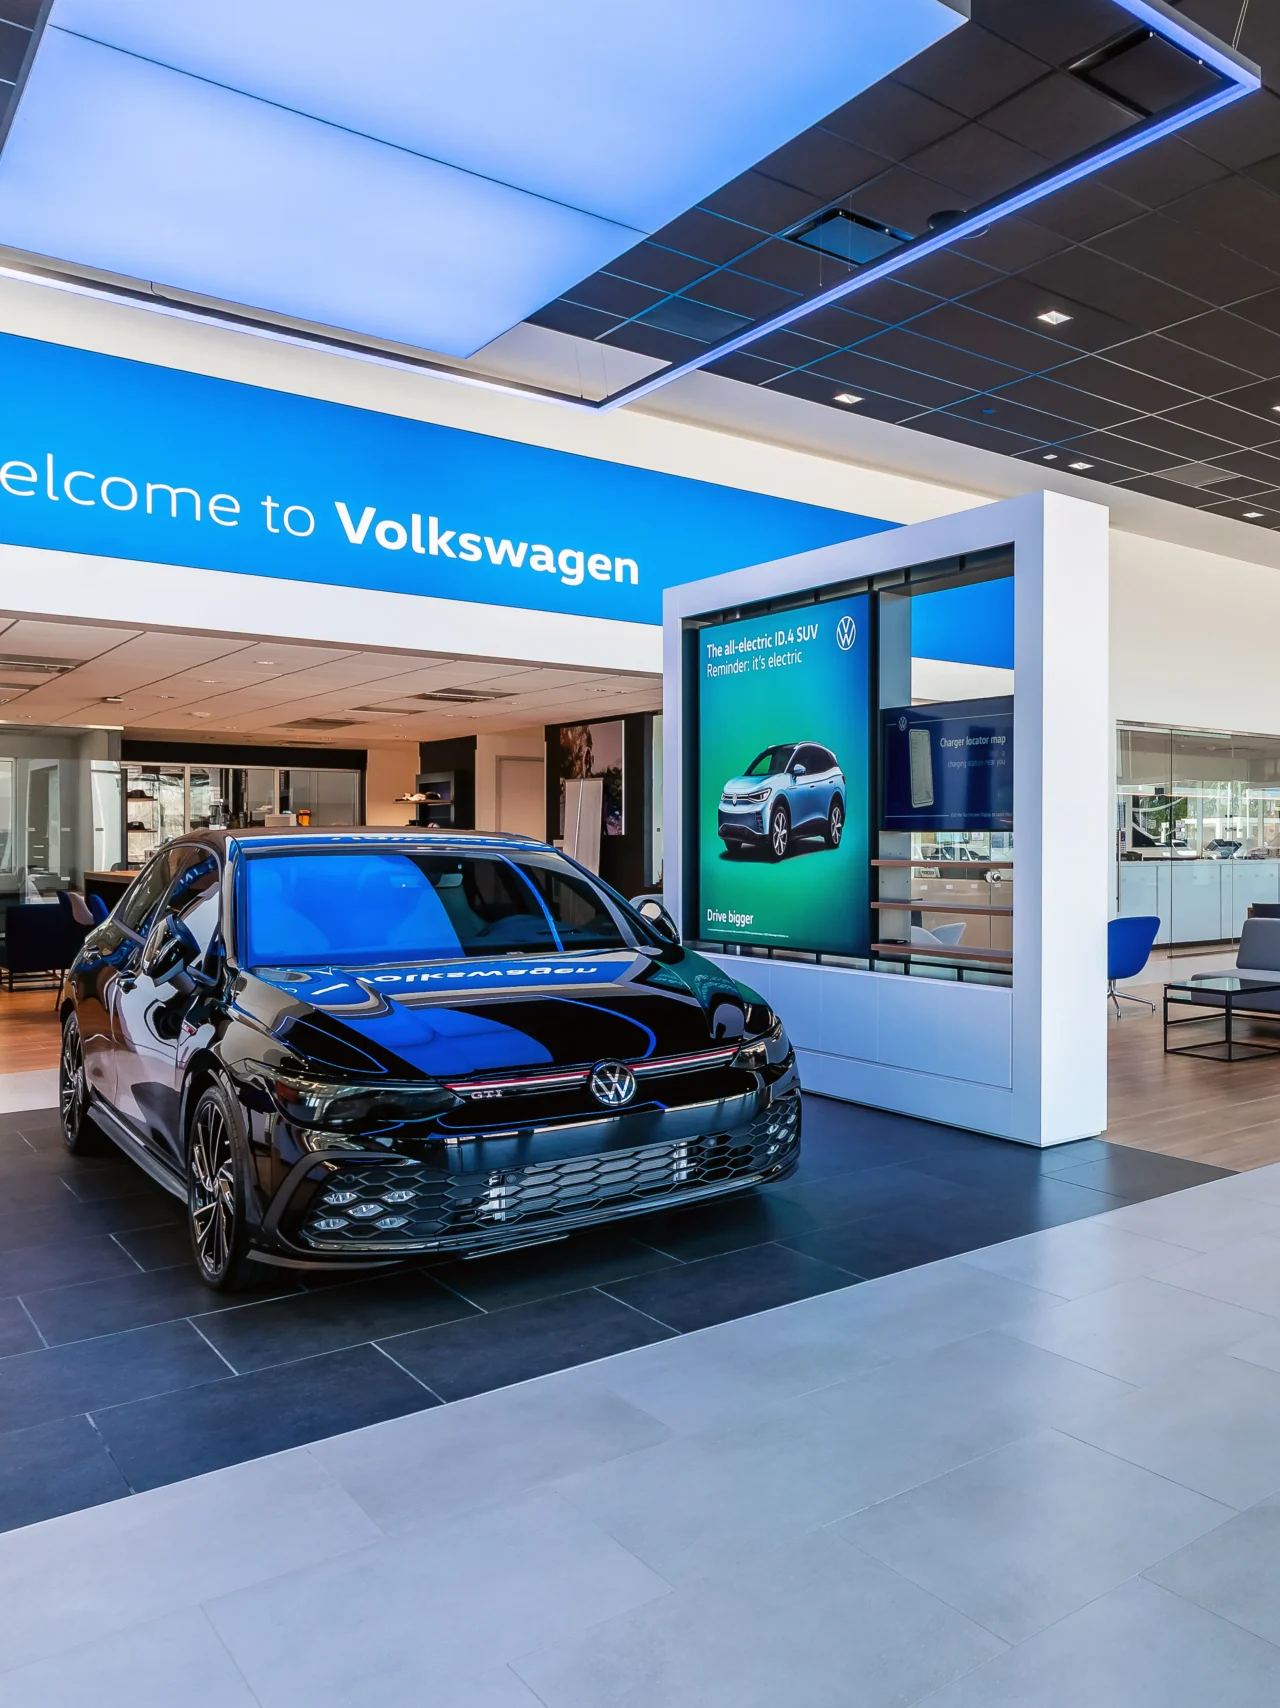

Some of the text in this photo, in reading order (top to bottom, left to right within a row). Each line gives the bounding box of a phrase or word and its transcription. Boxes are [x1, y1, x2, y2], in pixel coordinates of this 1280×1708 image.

[261, 495, 316, 538] to
[334, 501, 640, 586] Volkswagen
[706, 623, 819, 659] The all-electric ID.4 SUV
[706, 649, 803, 678] Reminder: it's electric
[940, 735, 1006, 749] Charger locator map
[707, 908, 754, 928] Drive bigger
[470, 1089, 503, 1100] GTI
